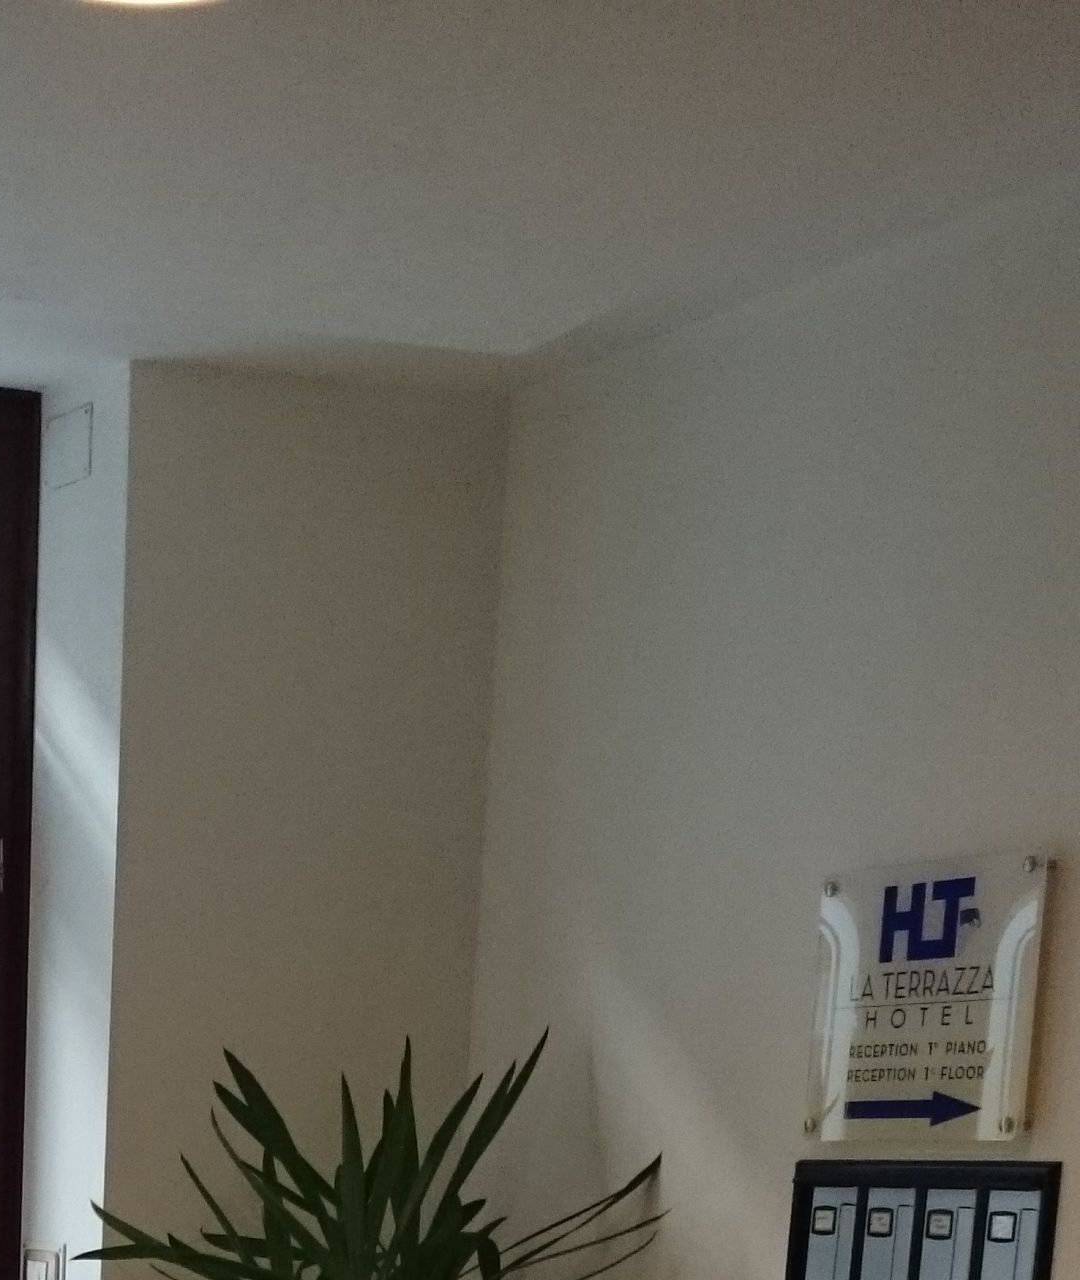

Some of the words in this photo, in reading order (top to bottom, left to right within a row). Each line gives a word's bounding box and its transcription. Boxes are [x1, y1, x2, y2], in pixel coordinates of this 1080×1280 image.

[850, 974, 873, 1002] LA
[883, 965, 995, 1000] TERRAZZA
[865, 1005, 973, 1031] HOTEL
[848, 1043, 918, 1059] RECEPTION
[945, 1040, 987, 1055] PIANO
[846, 1067, 916, 1082] RECEPTION
[940, 1066, 984, 1080] FLOOR
